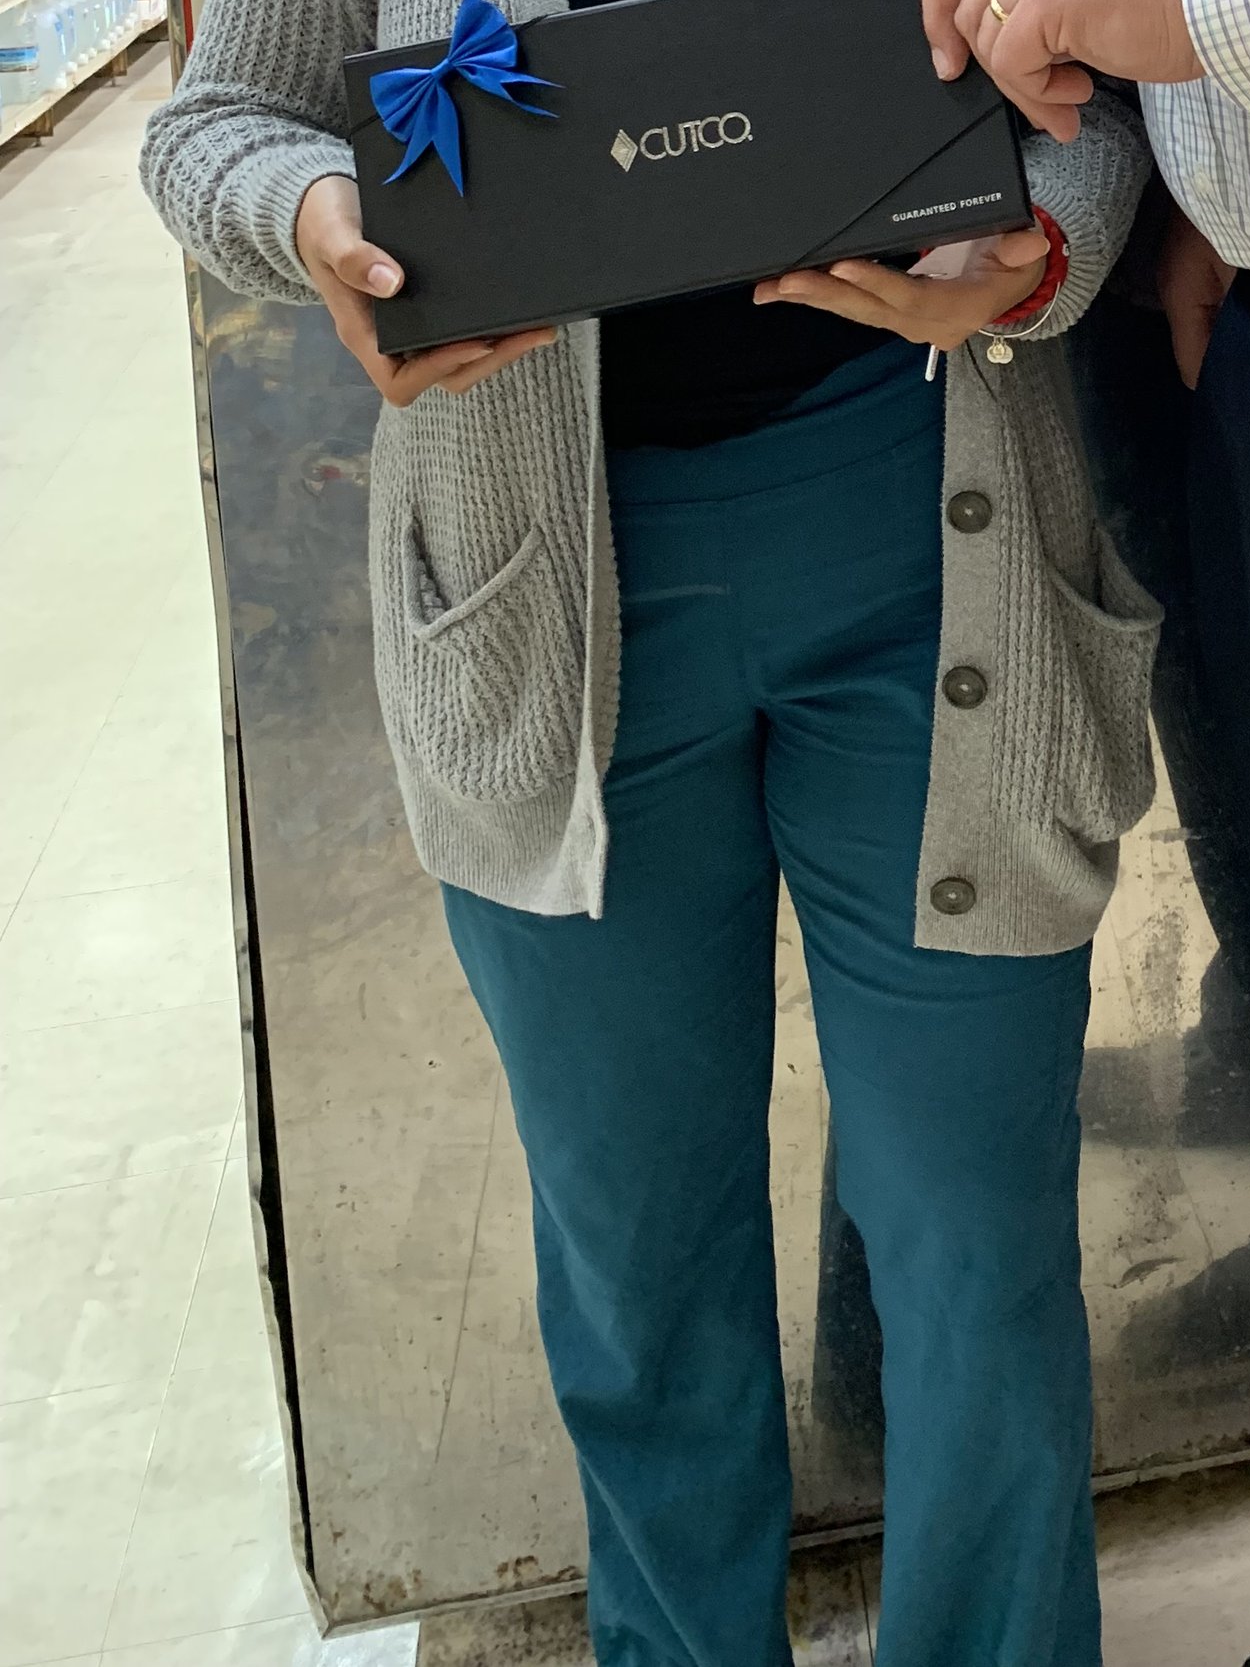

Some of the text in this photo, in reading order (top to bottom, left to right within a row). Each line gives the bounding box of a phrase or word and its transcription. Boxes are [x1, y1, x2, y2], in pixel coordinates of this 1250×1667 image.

[640, 111, 751, 160] CUTCO
[892, 192, 1002, 222] GUARANTEED FOREVER
